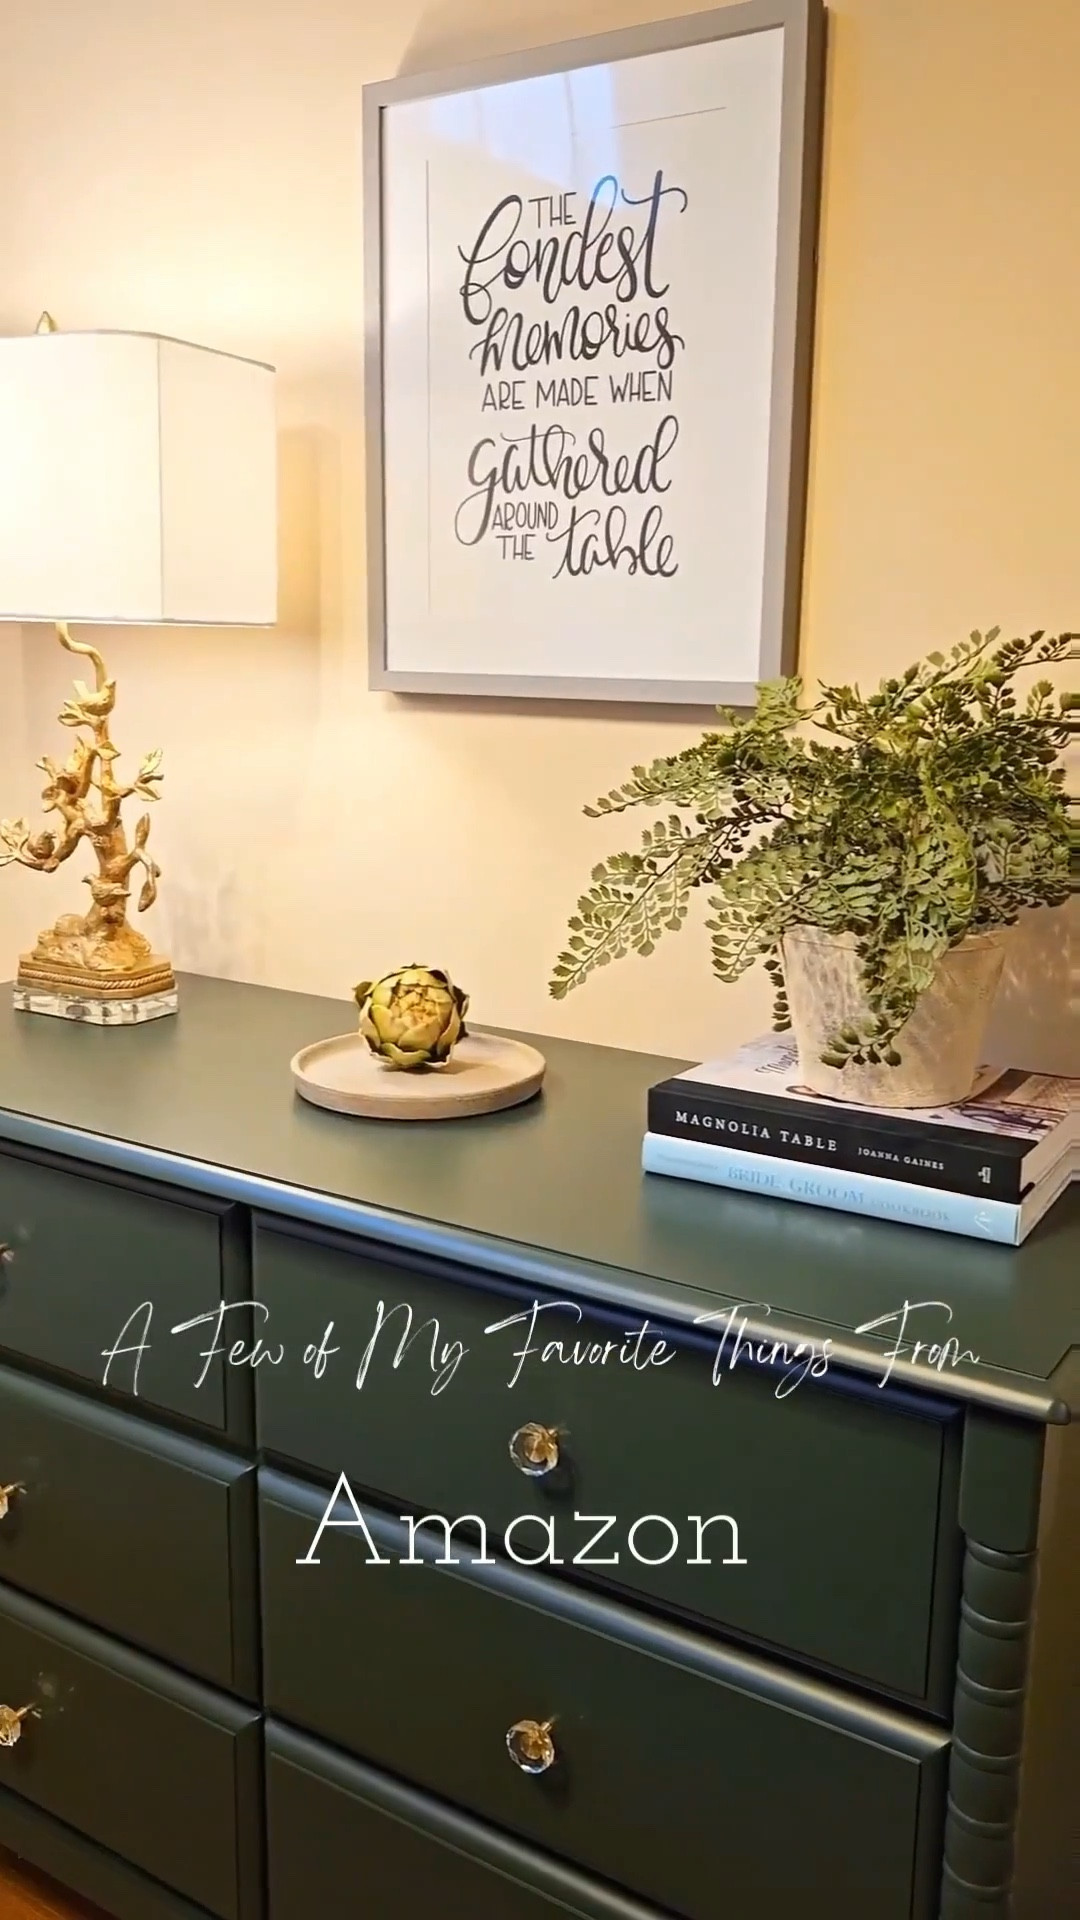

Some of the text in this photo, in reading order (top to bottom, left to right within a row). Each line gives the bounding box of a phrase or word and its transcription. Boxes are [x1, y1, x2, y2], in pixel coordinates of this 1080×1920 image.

[529, 191, 577, 228] THE
[458, 170, 688, 326] fondest
[469, 304, 685, 377] memories
[481, 370, 673, 412] ARE MADE WHEN
[454, 414, 679, 546] gathered
[491, 501, 559, 531] AROUND
[495, 505, 679, 579] THE table
[674, 1110, 837, 1151] MAGNOLIA TABLE
[858, 1147, 944, 1170] JOANNA GAINES
[728, 1166, 780, 1188] BRIDE
[789, 1178, 864, 1202] GROOM
